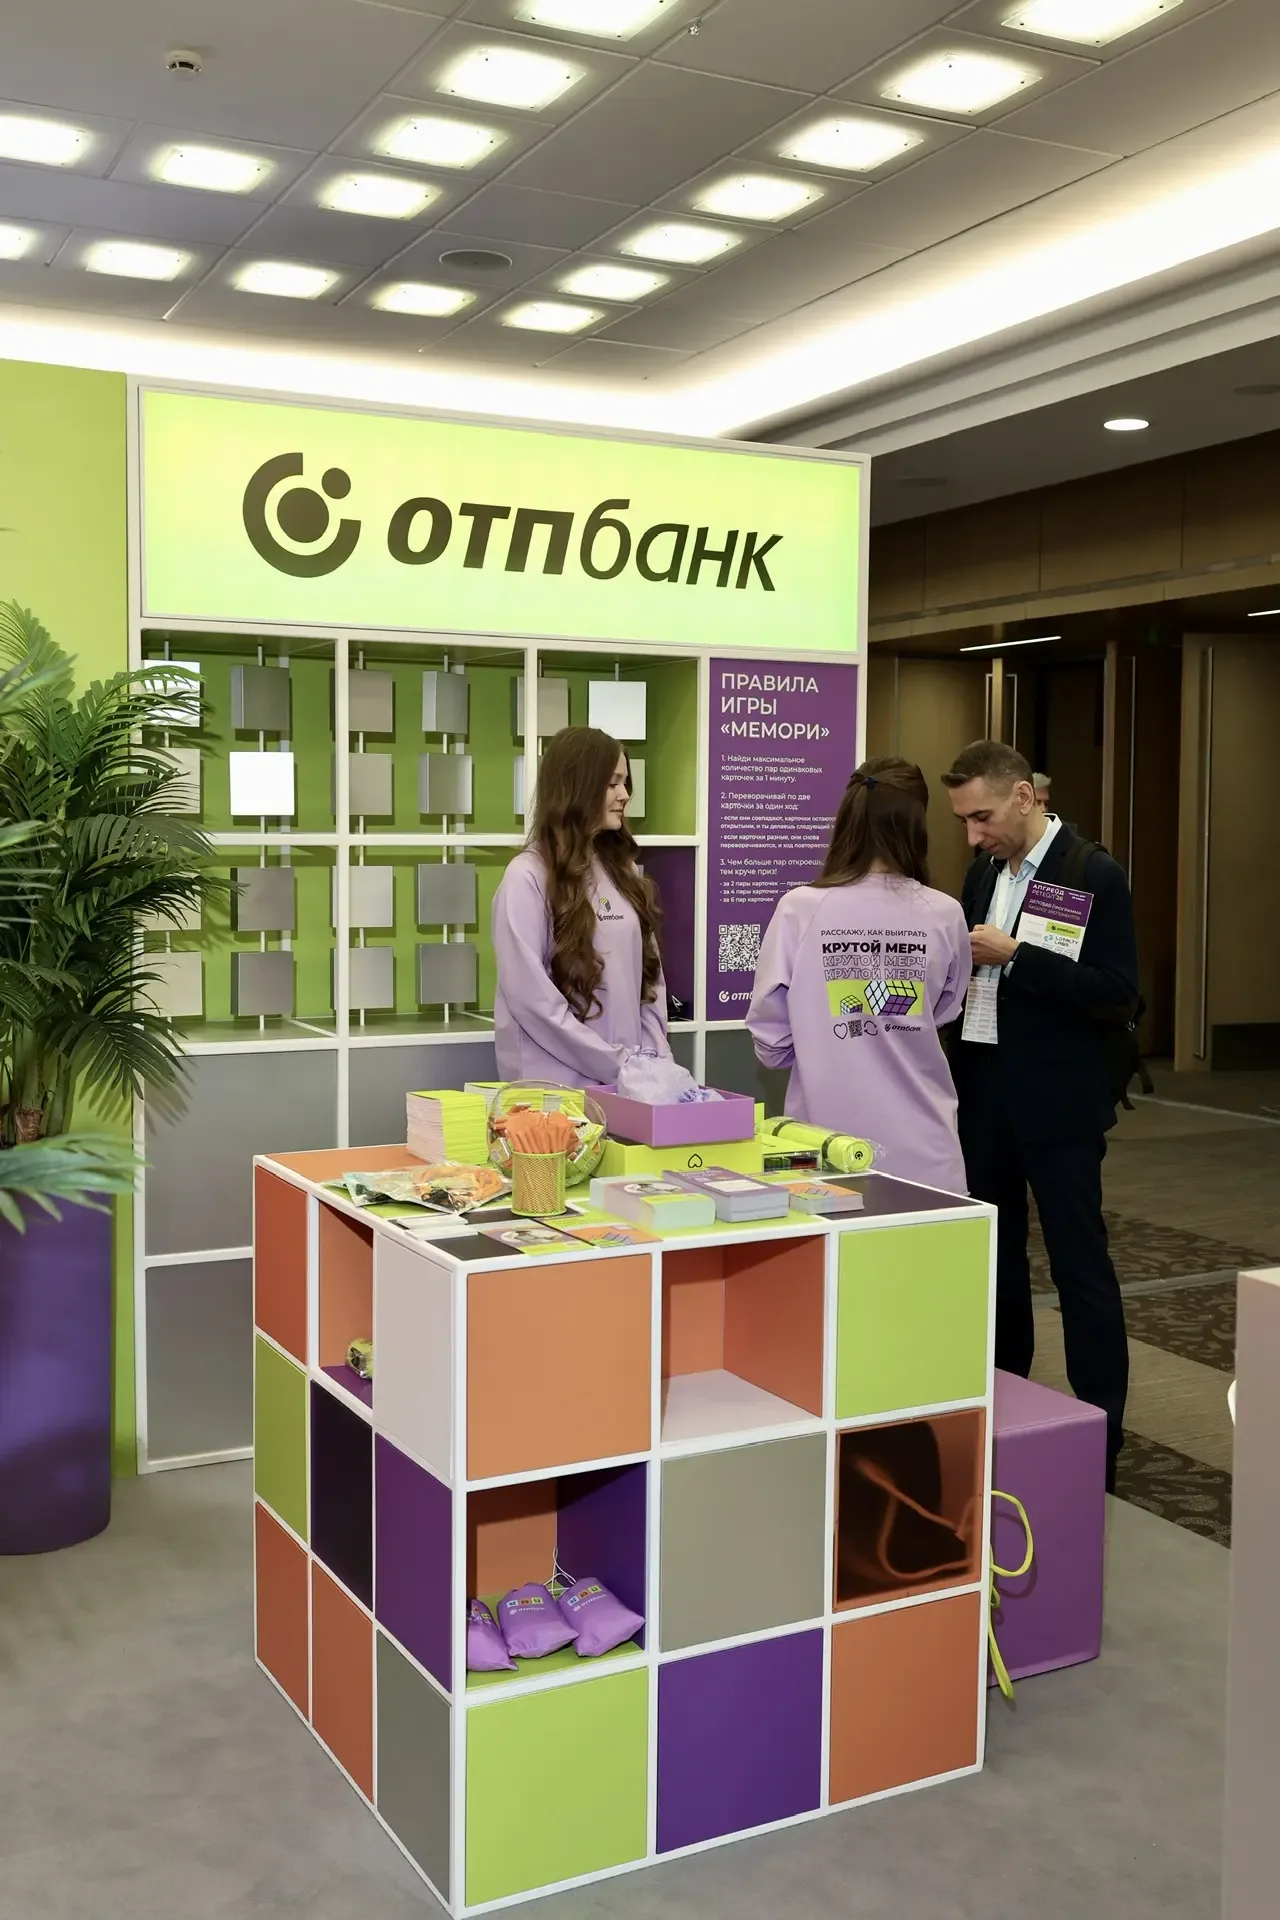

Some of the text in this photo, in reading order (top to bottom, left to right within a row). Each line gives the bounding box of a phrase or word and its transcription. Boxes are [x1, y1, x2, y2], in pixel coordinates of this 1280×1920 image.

[722, 673, 819, 693] ПРАВИЛА
[721, 697, 776, 715] ИГРЫ
[721, 721, 830, 740] «МЕМОРИ»
[744, 858, 772, 866] больше
[758, 868, 777, 876] приз!
[822, 940, 926, 954] КРУТОЙ МЕРЧ
[823, 953, 926, 968] КРУТОЙ МЕРЧ
[824, 966, 925, 981] КРУТОЙ МЕРЧ
